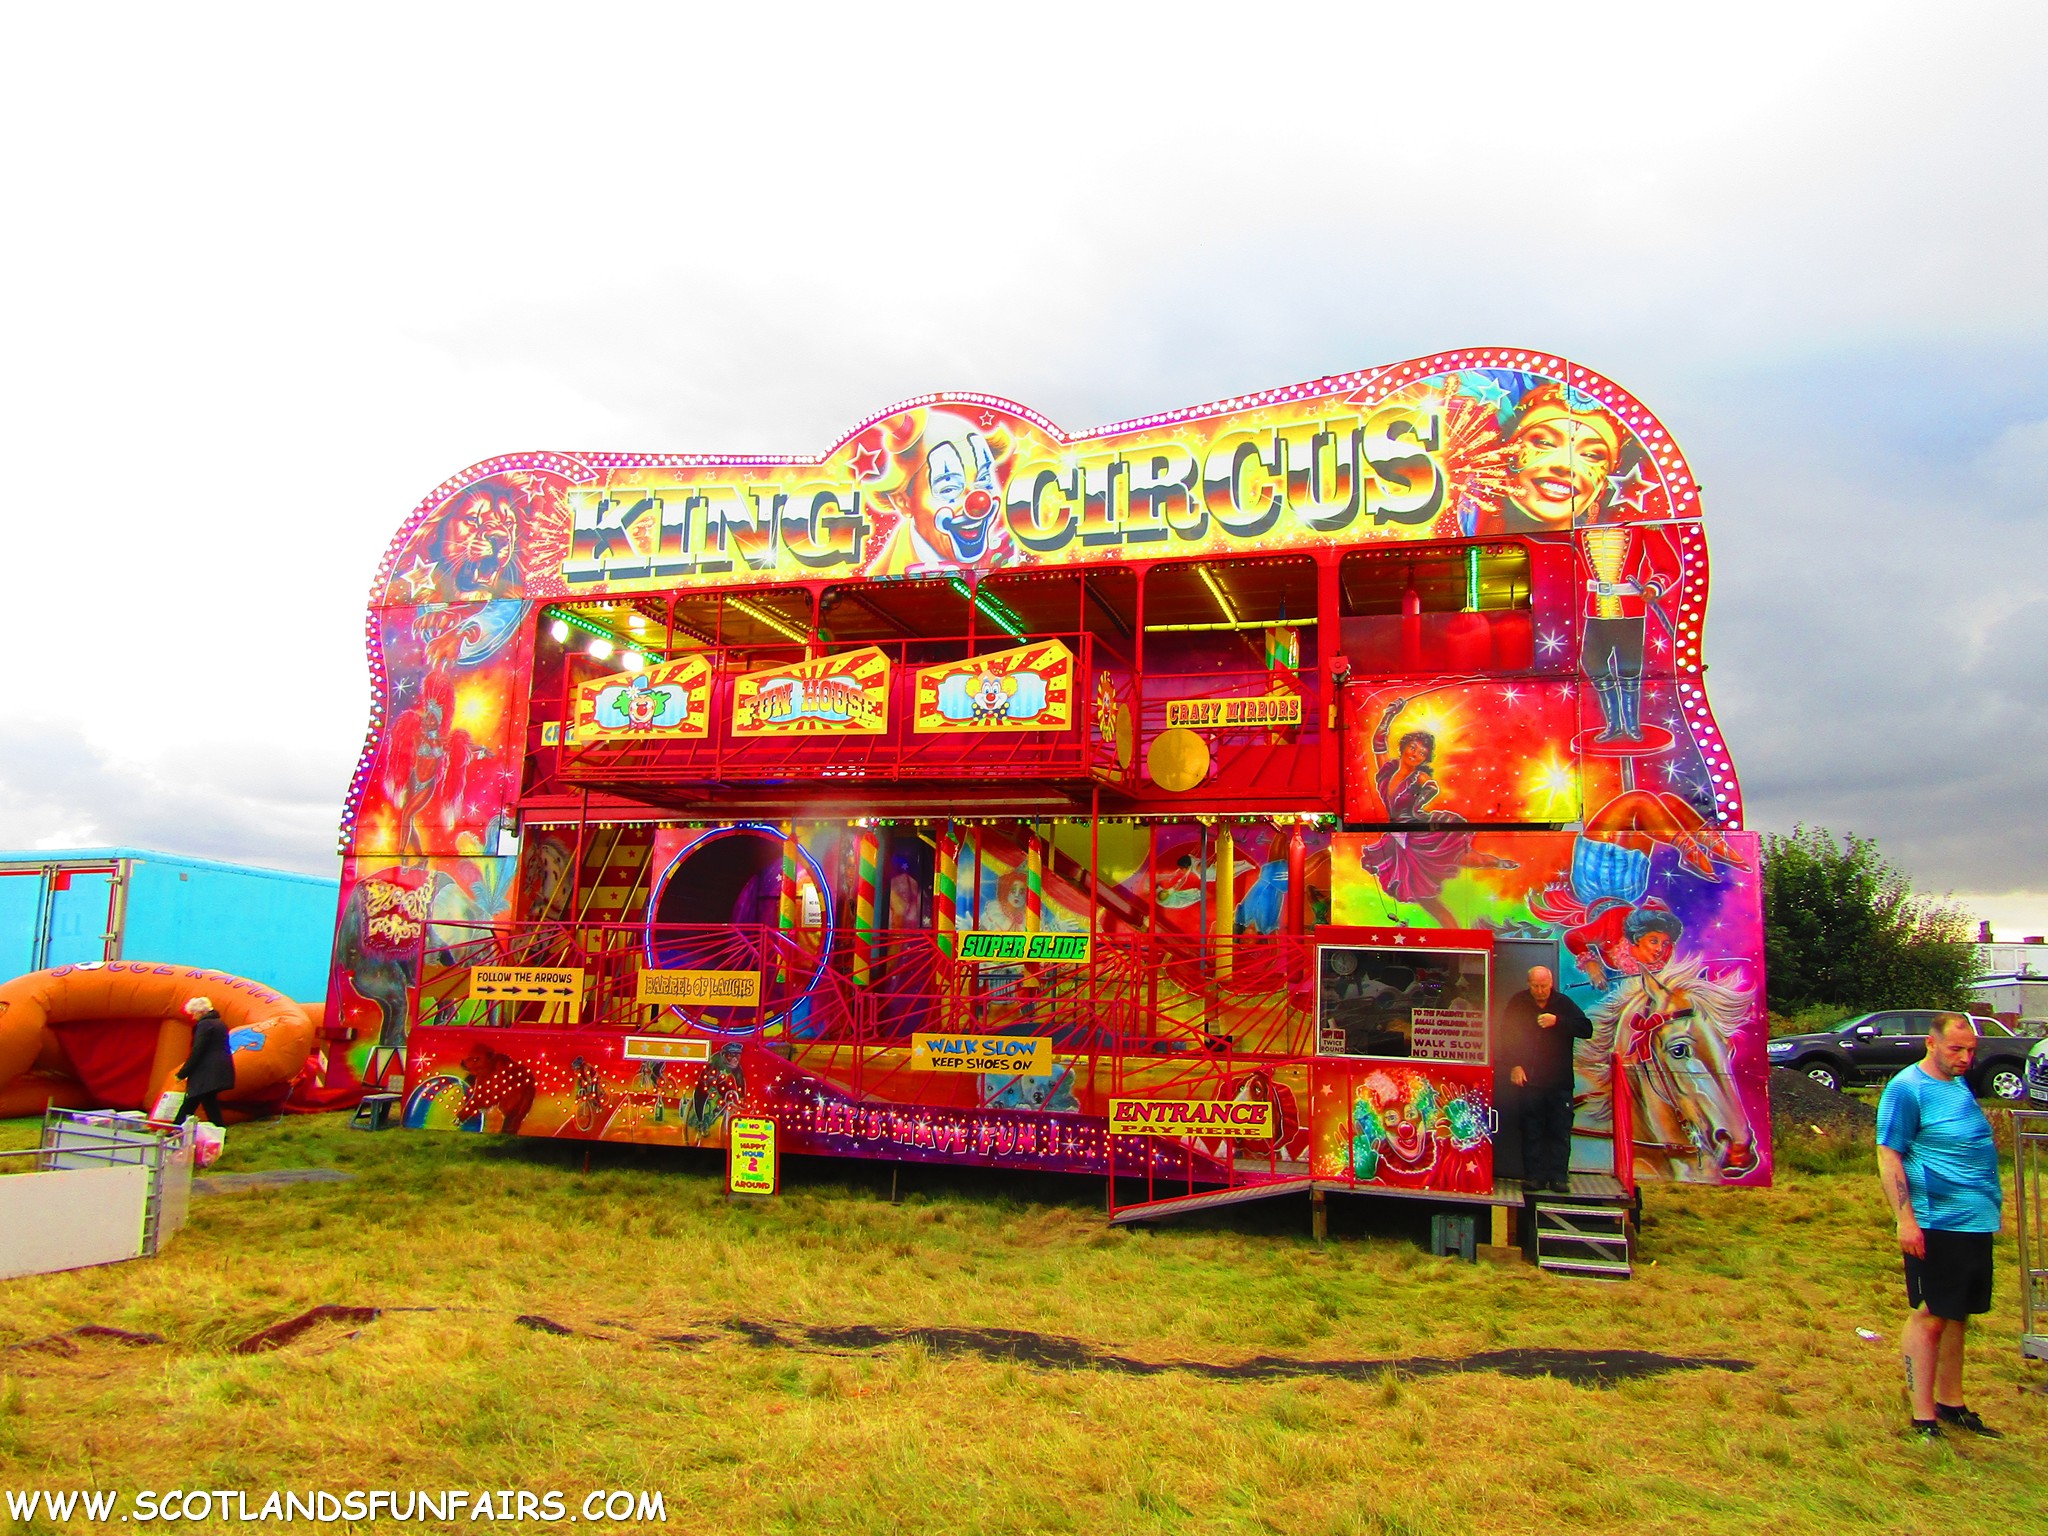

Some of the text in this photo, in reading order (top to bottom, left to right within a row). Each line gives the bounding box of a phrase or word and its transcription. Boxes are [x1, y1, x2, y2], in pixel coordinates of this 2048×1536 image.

[561, 404, 1446, 584] KING CIRCUS
[739, 678, 878, 726] FUN HOUSE
[1169, 700, 1299, 725] CRAZY MIRRORS
[961, 934, 1089, 960] SUPER SLIDE
[477, 972, 573, 984] FOLLOW THE ARROWS
[645, 974, 755, 998] BARREL OF LAUGHS
[926, 1038, 1038, 1057] WALK SLOW
[1414, 1039, 1483, 1049] WALK SLOW
[931, 1057, 1033, 1070] KEEP SHOES ON
[1412, 1049, 1485, 1060] NO RUNNING
[1113, 1102, 1269, 1125] ENTRANCE
[815, 1101, 883, 1141] LET'S
[893, 1119, 972, 1155] HAVE
[1121, 1125, 1261, 1136] PAY HERE
[748, 1157, 758, 1172] 2
[735, 1180, 770, 1189] AROUND
